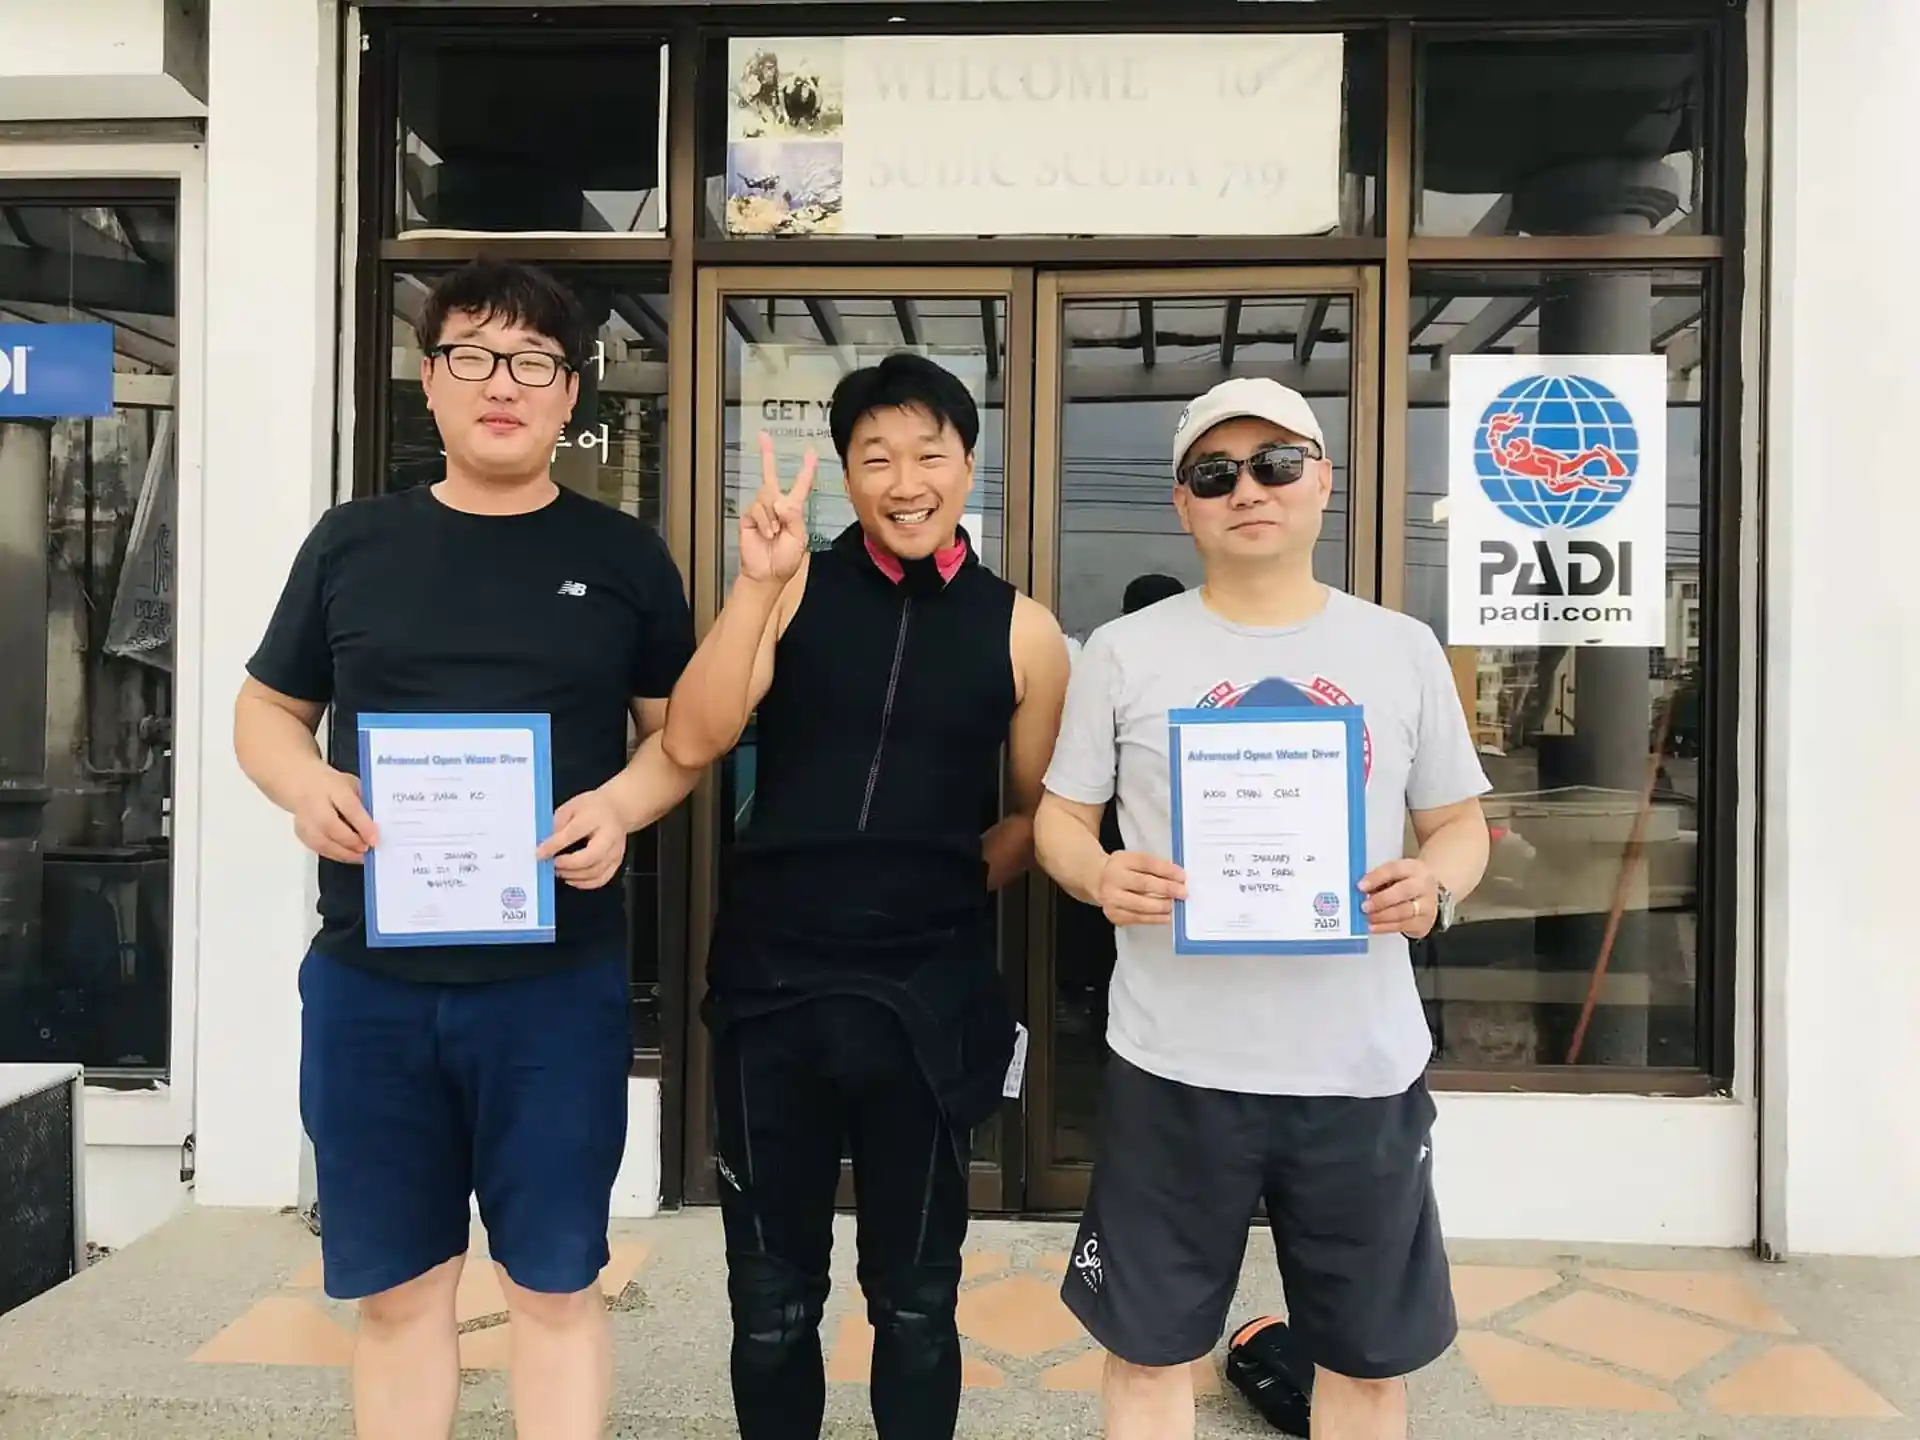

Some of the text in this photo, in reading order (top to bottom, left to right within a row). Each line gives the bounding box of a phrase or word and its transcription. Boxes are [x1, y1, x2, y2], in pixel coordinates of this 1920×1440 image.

[762, 399, 810, 421] GET
[1479, 540, 1633, 597] PADI
[1479, 602, 1633, 626] padi.com
[377, 752, 529, 768] Advanced Open Water Diver
[1187, 747, 1341, 763] Advanced Open Water Diver
[502, 910, 527, 920] PADI
[1314, 917, 1340, 929] PADI
